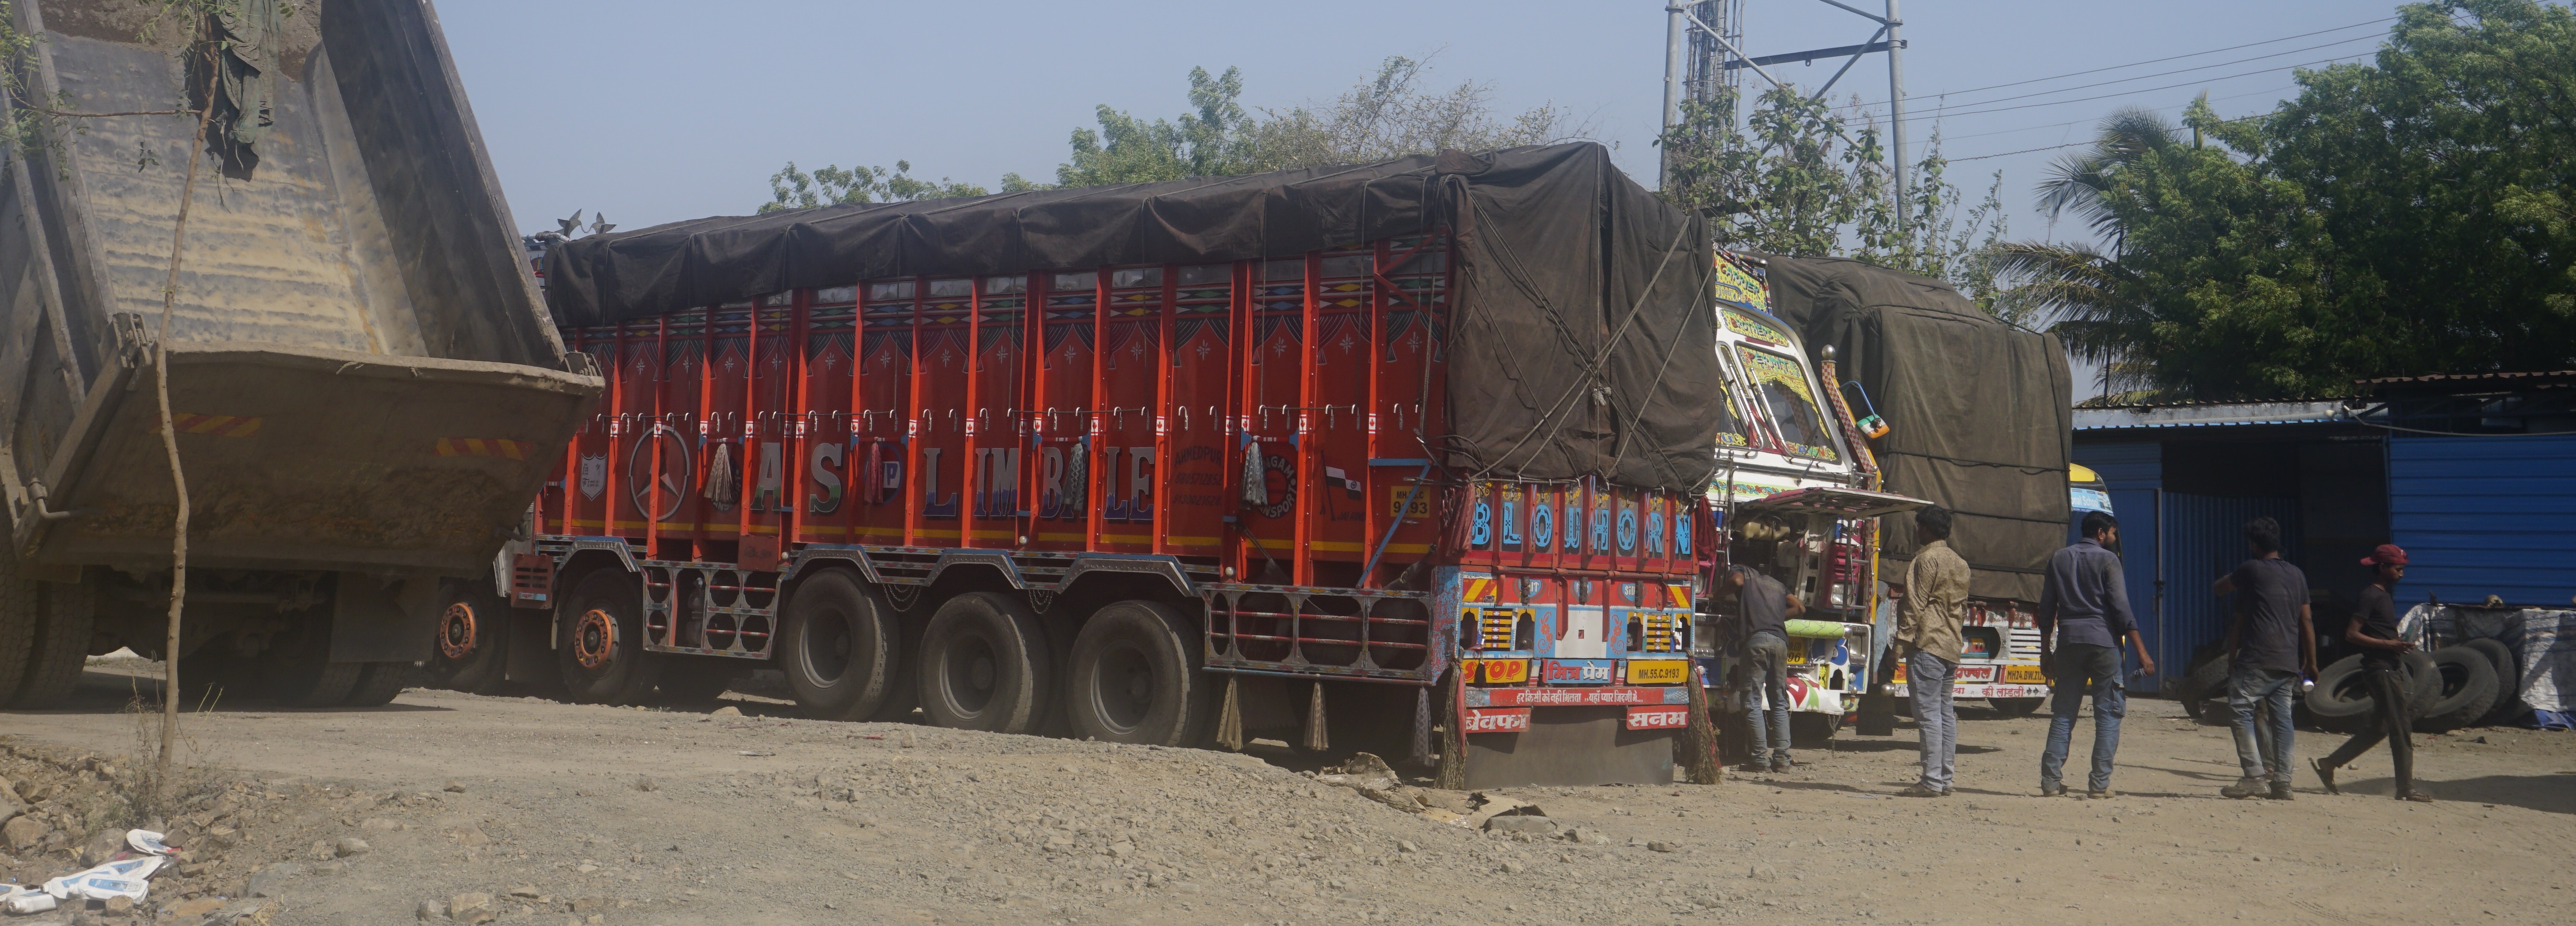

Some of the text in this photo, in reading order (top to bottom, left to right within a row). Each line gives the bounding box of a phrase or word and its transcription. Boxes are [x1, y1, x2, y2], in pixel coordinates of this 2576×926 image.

[1720, 263, 1760, 297] CARRIER
[1747, 351, 1789, 372] PERMIT
[750, 442, 781, 510] A
[809, 442, 843, 513] S
[1396, 491, 1424, 499] MH..C
[2083, 495, 2098, 507] School
[1471, 502, 1691, 554] BLOWHORN
[1547, 660, 1610, 680] मित्र प्रेम
[1638, 668, 1680, 679] MH.55.C.9193
[1541, 689, 1550, 702] को
[1981, 685, 1994, 697] की
[1996, 686, 2024, 698] लाडली
[1629, 711, 1688, 727] सनम
